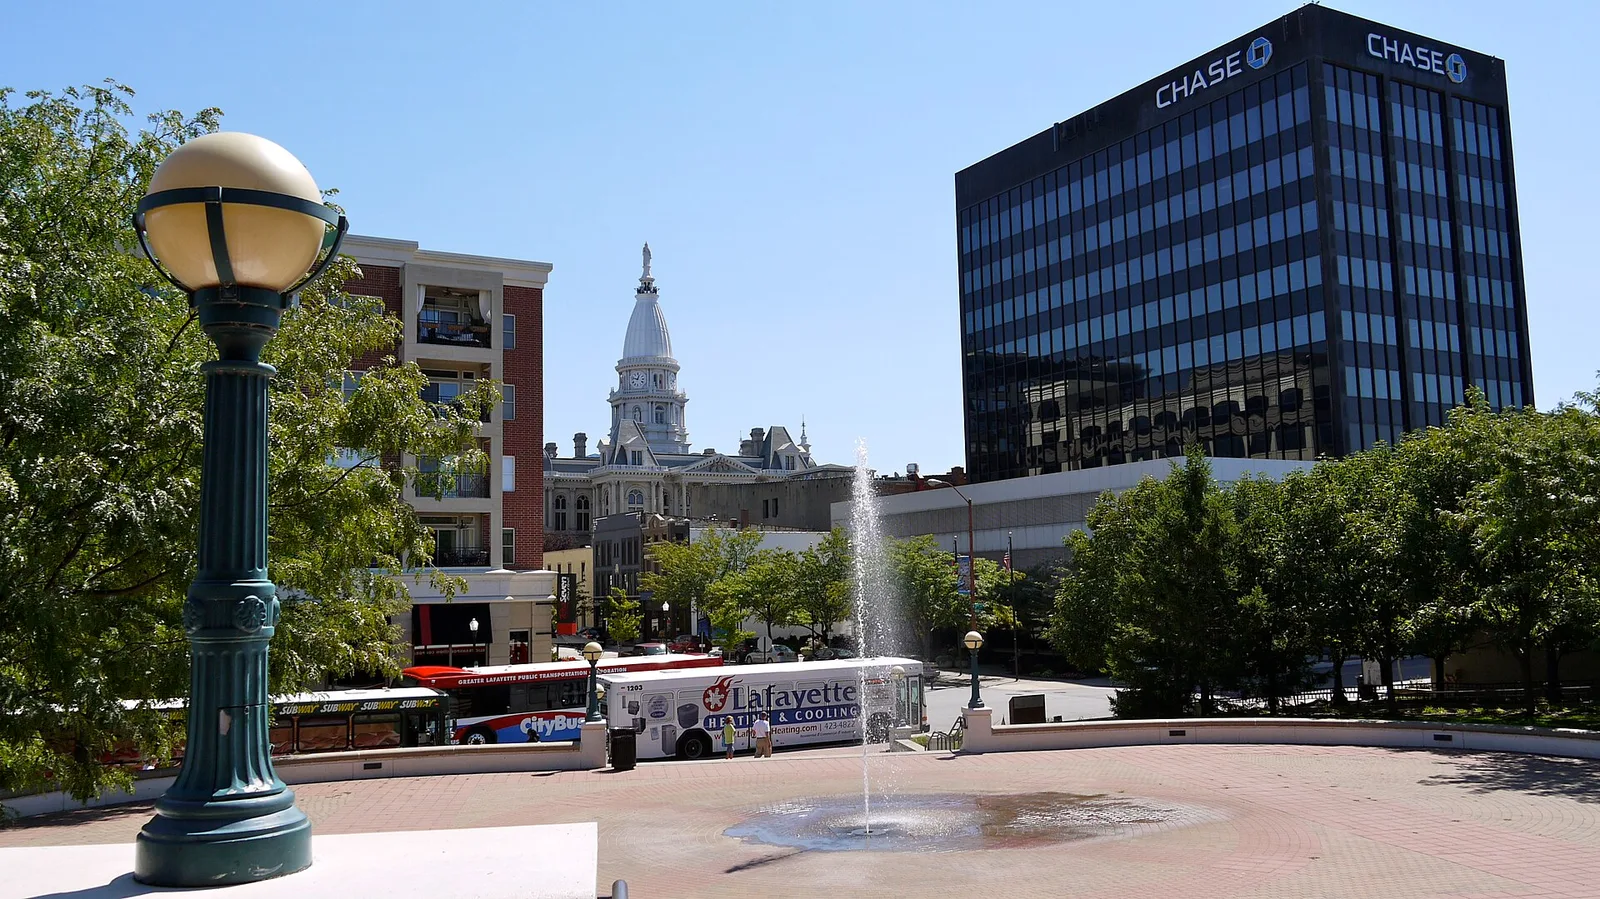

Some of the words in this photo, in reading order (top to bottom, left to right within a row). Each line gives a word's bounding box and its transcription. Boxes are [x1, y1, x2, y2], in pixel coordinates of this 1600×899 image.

[1367, 33, 1446, 76] CHASE
[1155, 50, 1242, 109] CHASE
[559, 576, 567, 603] Seven
[486, 675, 516, 683] LAFAYETTE
[517, 673, 538, 681] PUBLIC
[539, 671, 587, 679] TRANSPORTATION
[279, 704, 319, 715] SUBWAY
[320, 702, 360, 713] SUBWAY
[360, 700, 399, 711] SUBWAY
[400, 699, 437, 709] SUBWAY
[733, 683, 857, 710] Lafayette
[520, 714, 585, 737] CityBus
[778, 711, 788, 723] &
[795, 706, 858, 721] COOLING
